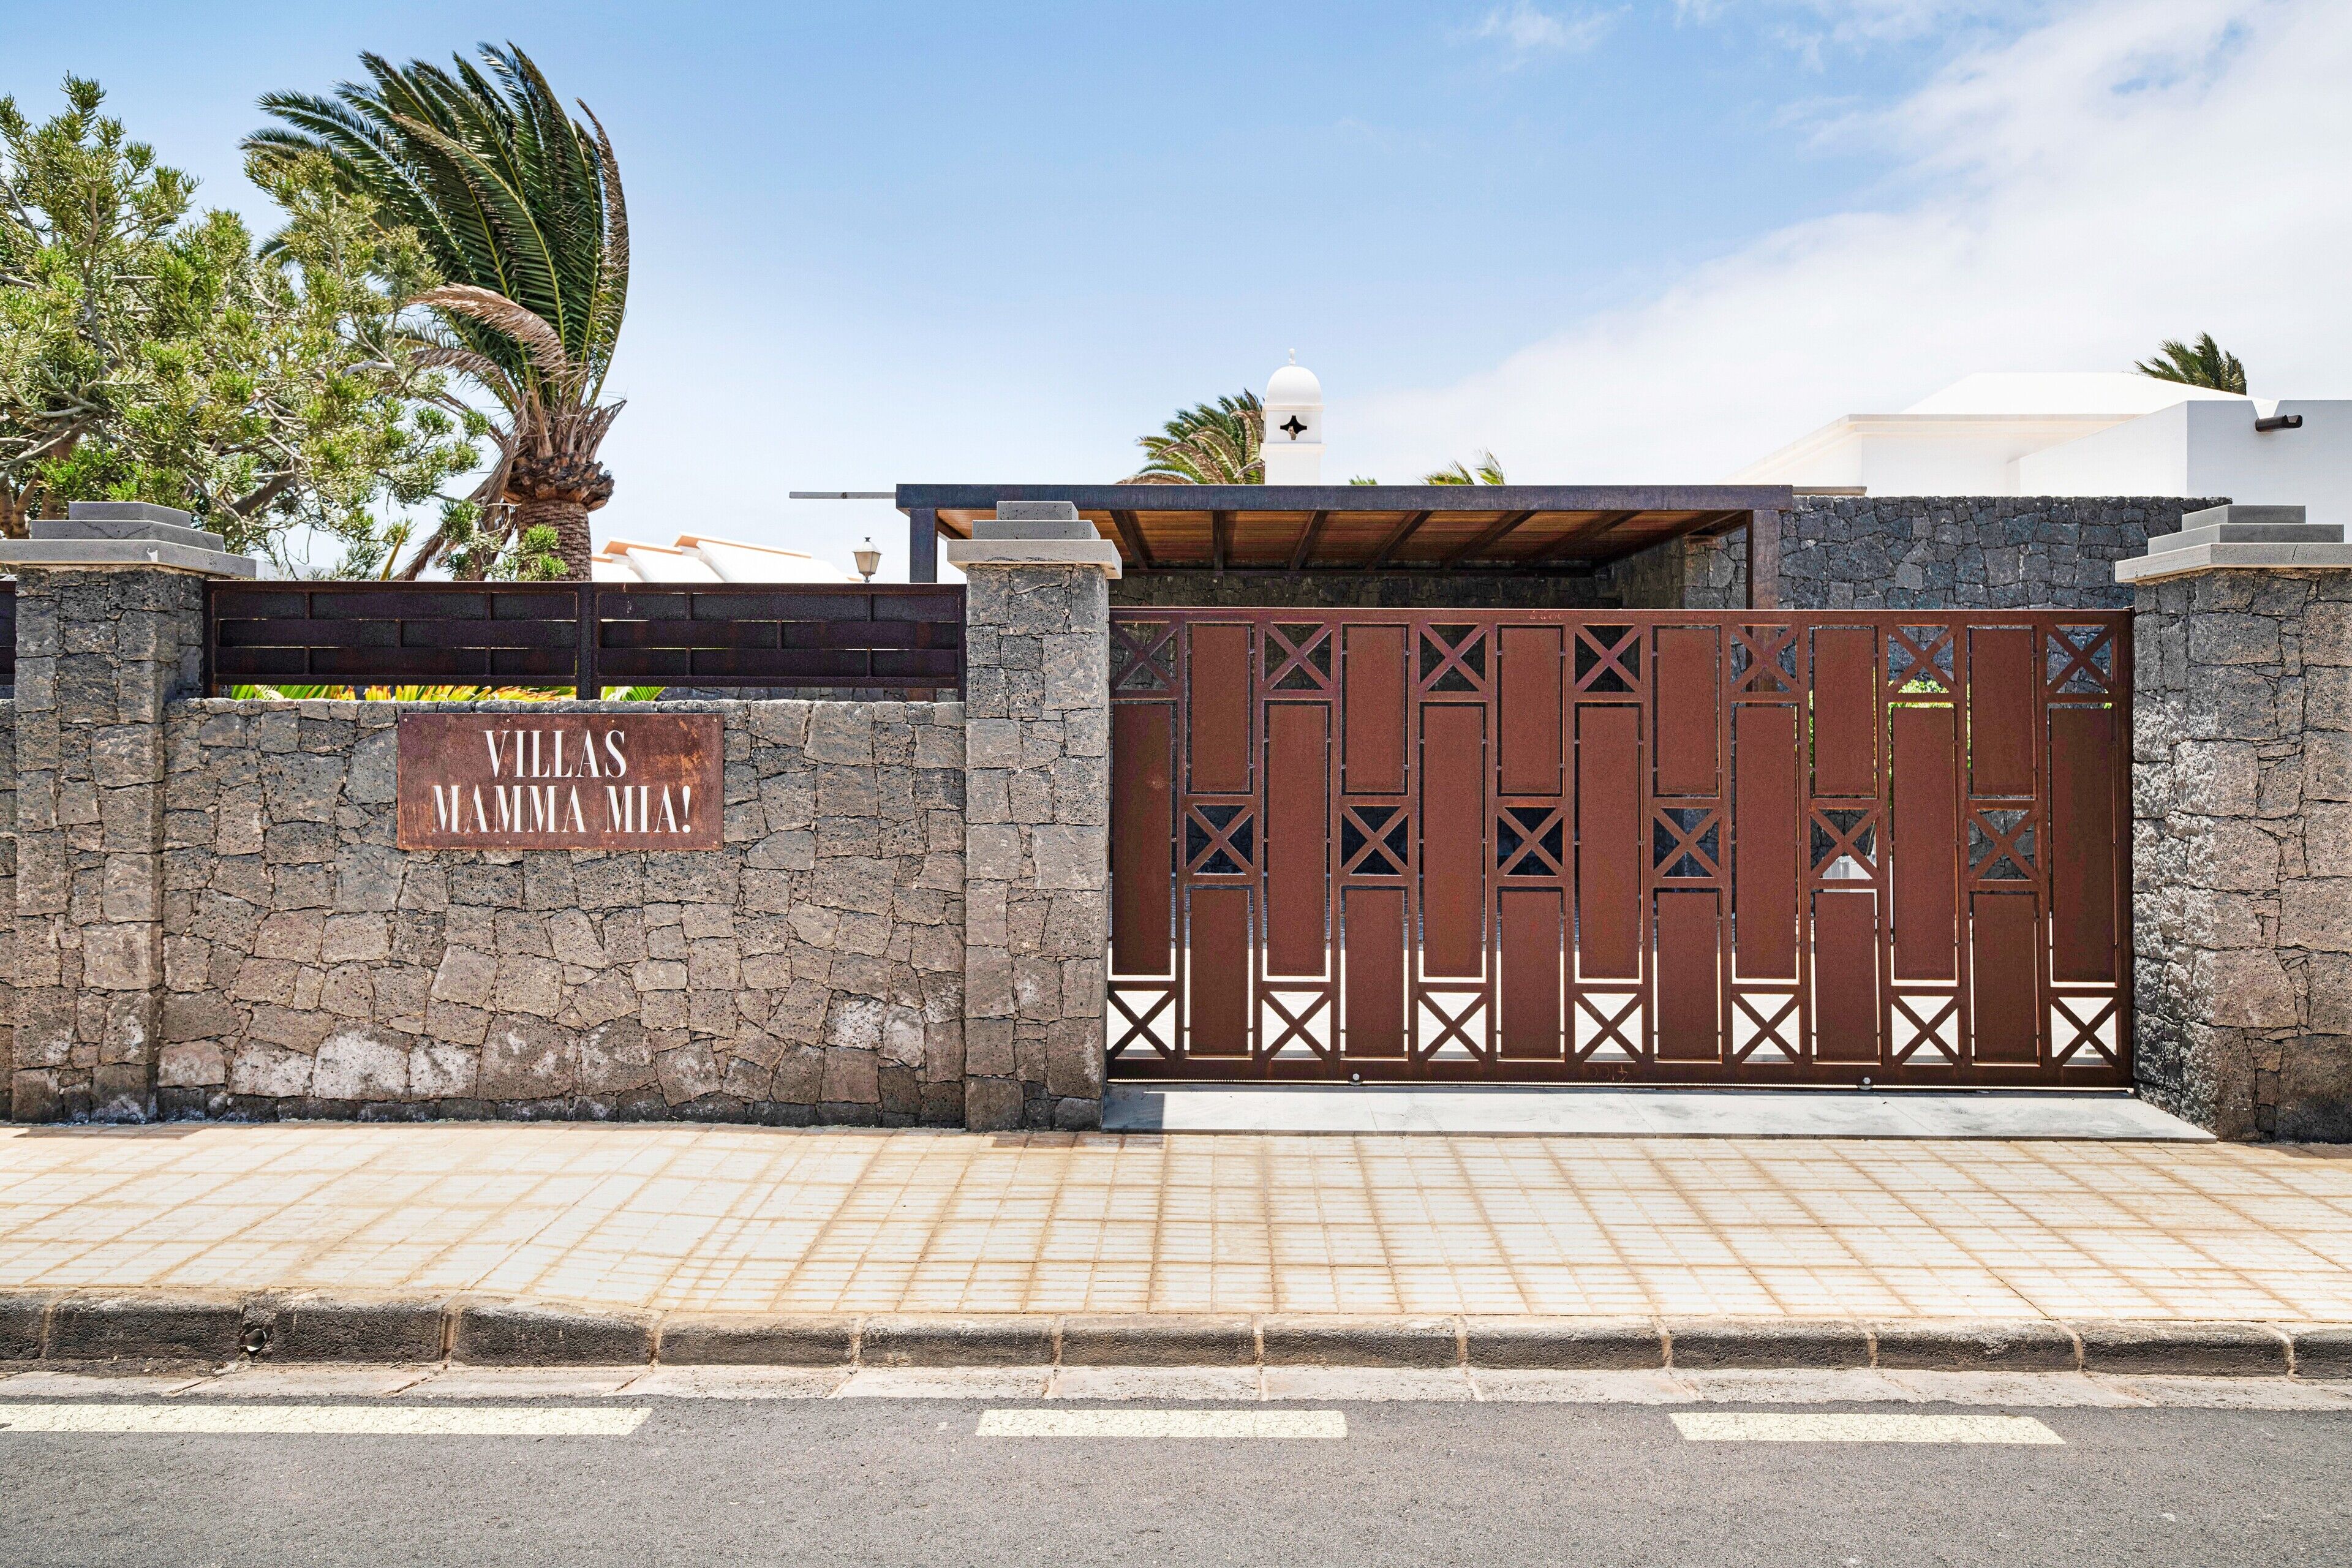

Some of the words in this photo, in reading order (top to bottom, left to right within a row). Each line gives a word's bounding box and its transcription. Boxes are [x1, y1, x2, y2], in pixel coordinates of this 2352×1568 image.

[483, 730, 627, 778] VILLAS
[432, 785, 586, 833] MAMMA
[605, 785, 692, 834] MIA!
